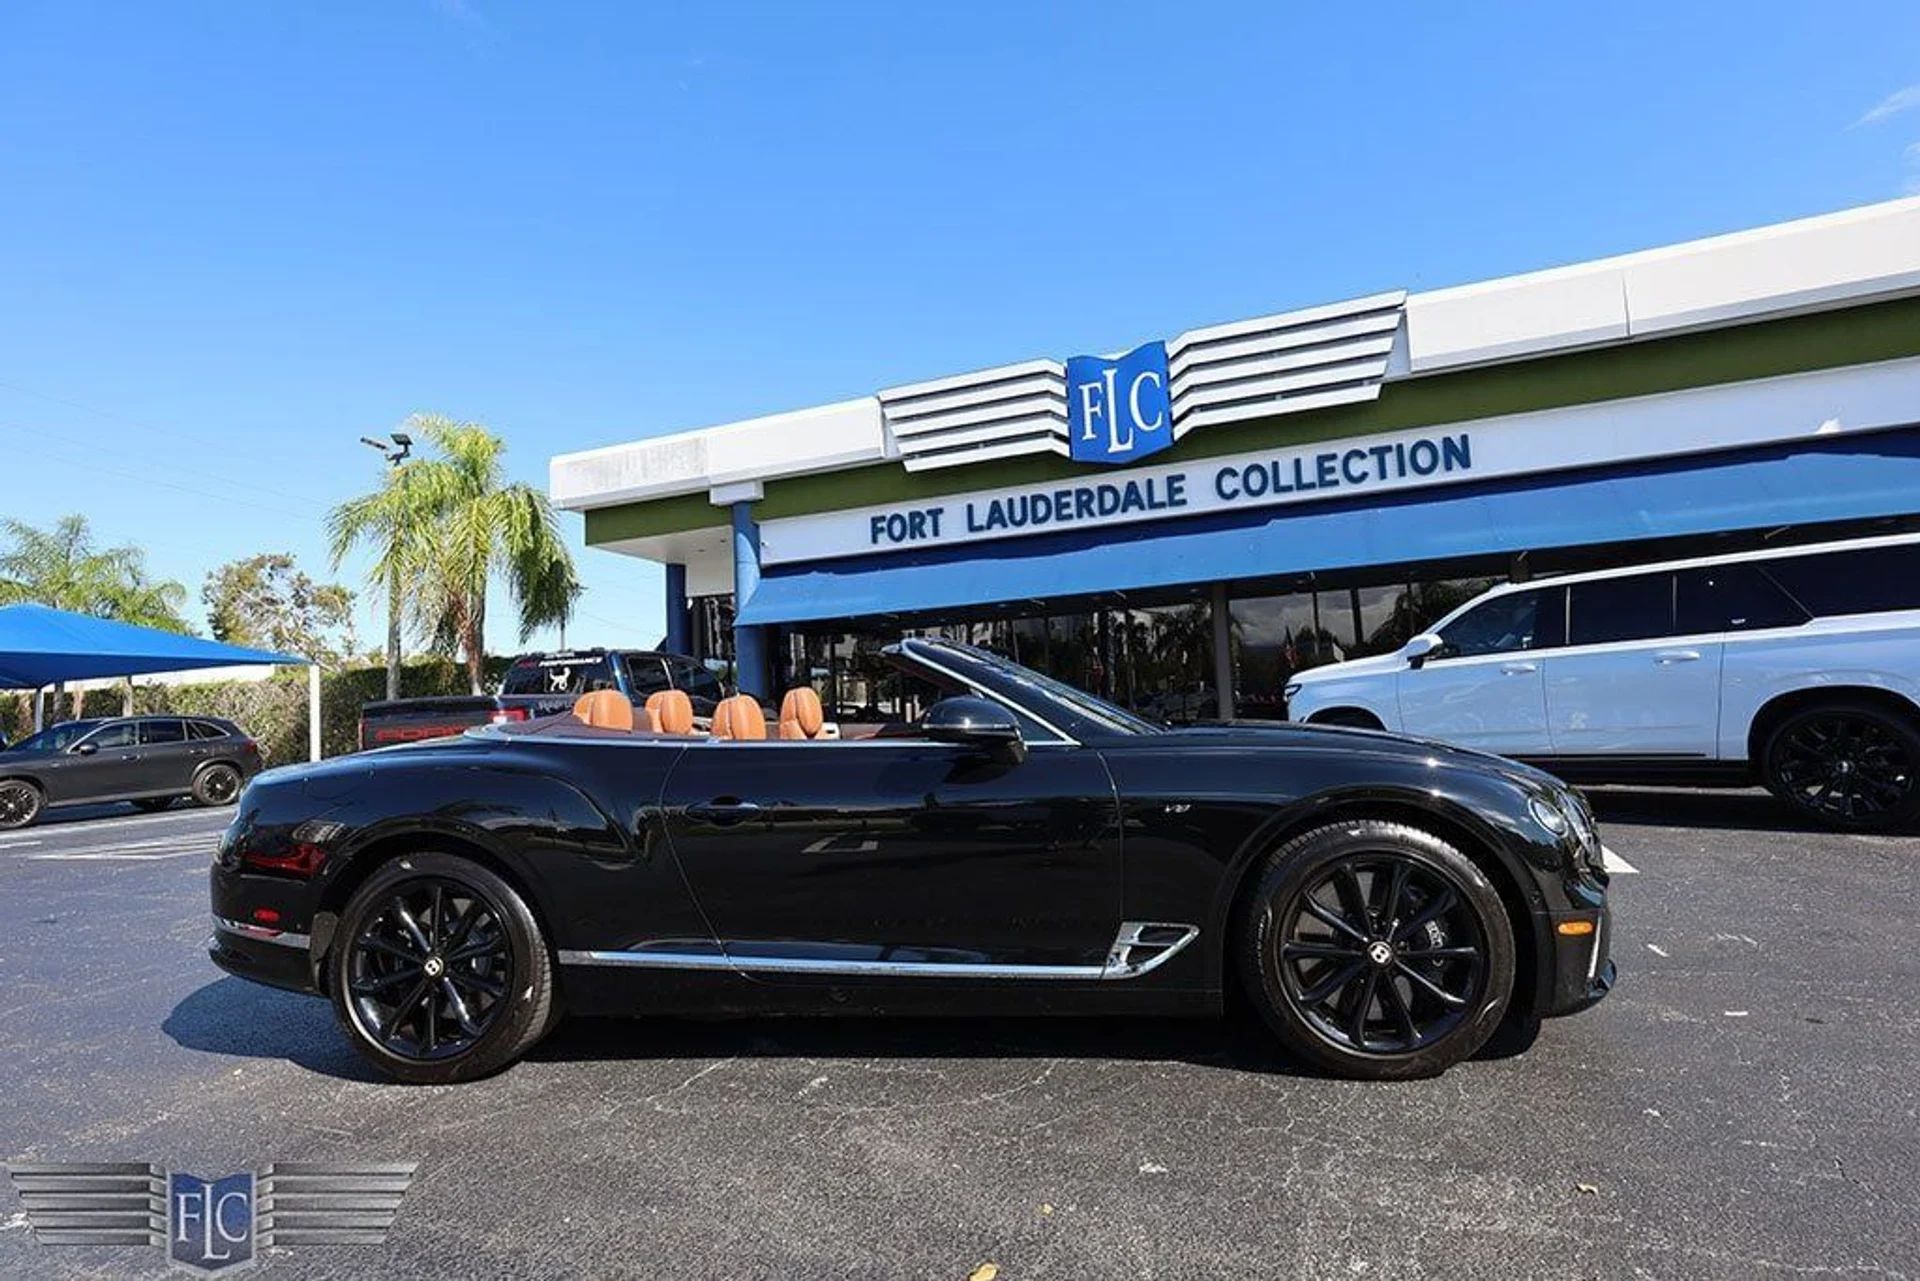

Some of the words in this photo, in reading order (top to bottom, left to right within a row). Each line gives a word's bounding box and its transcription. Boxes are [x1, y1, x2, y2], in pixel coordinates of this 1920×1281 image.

[1079, 368, 1163, 453] FLC
[870, 507, 944, 544] FORT
[966, 475, 1187, 533] LAUDERDALE
[1215, 434, 1472, 501] COLLECTION
